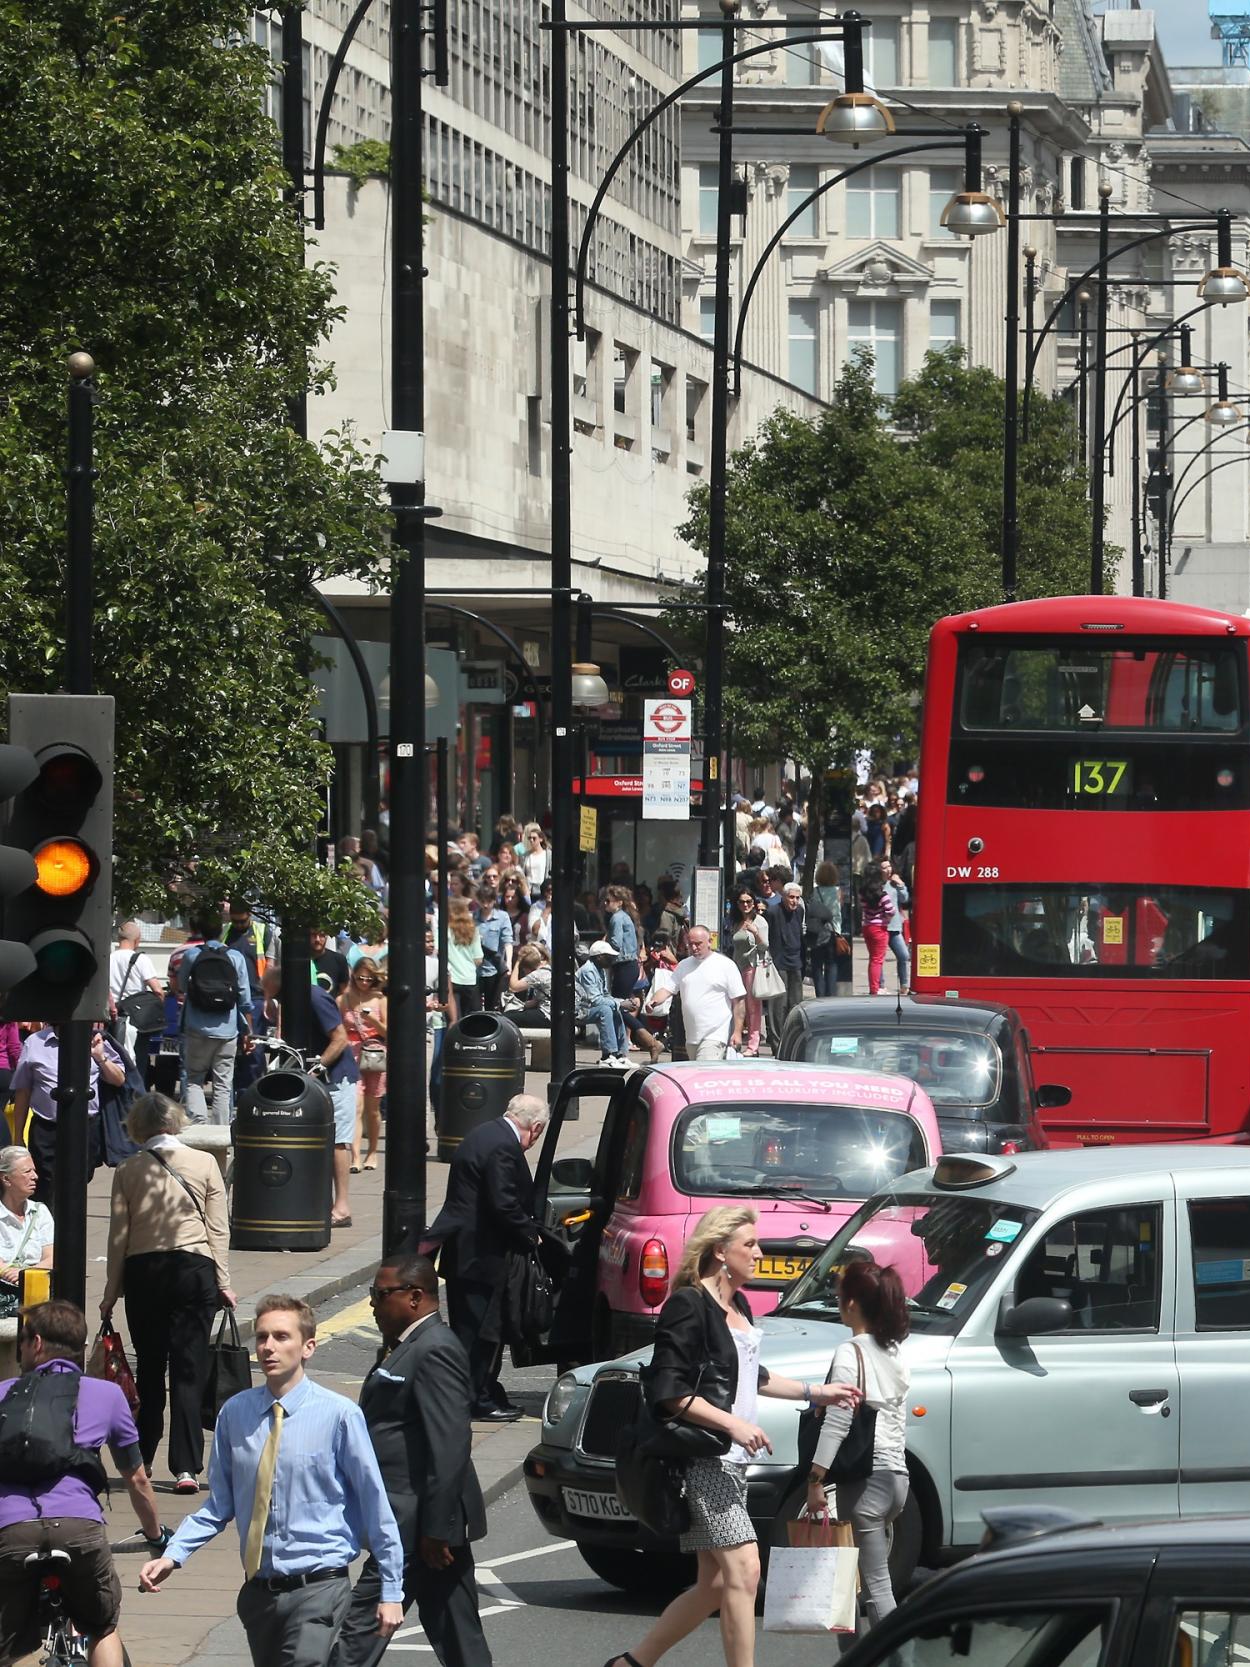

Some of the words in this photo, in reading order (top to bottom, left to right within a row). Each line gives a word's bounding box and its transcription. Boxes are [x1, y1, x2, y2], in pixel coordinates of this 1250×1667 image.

[671, 678, 690, 689] OF
[1074, 761, 1128, 794] 137
[947, 866, 972, 878] DW
[977, 866, 999, 878] 288
[693, 1079, 741, 1090] LOVE
[748, 1079, 765, 1088] IS
[767, 1079, 800, 1088] ALL
[806, 1079, 848, 1090] YOU
[854, 1084, 905, 1097] NEED
[698, 1089, 724, 1097] THE
[728, 1088, 758, 1097] REST
[762, 1088, 770, 1096] IS
[773, 1087, 827, 1097] LUXURY
[567, 1490, 599, 1514] S770
